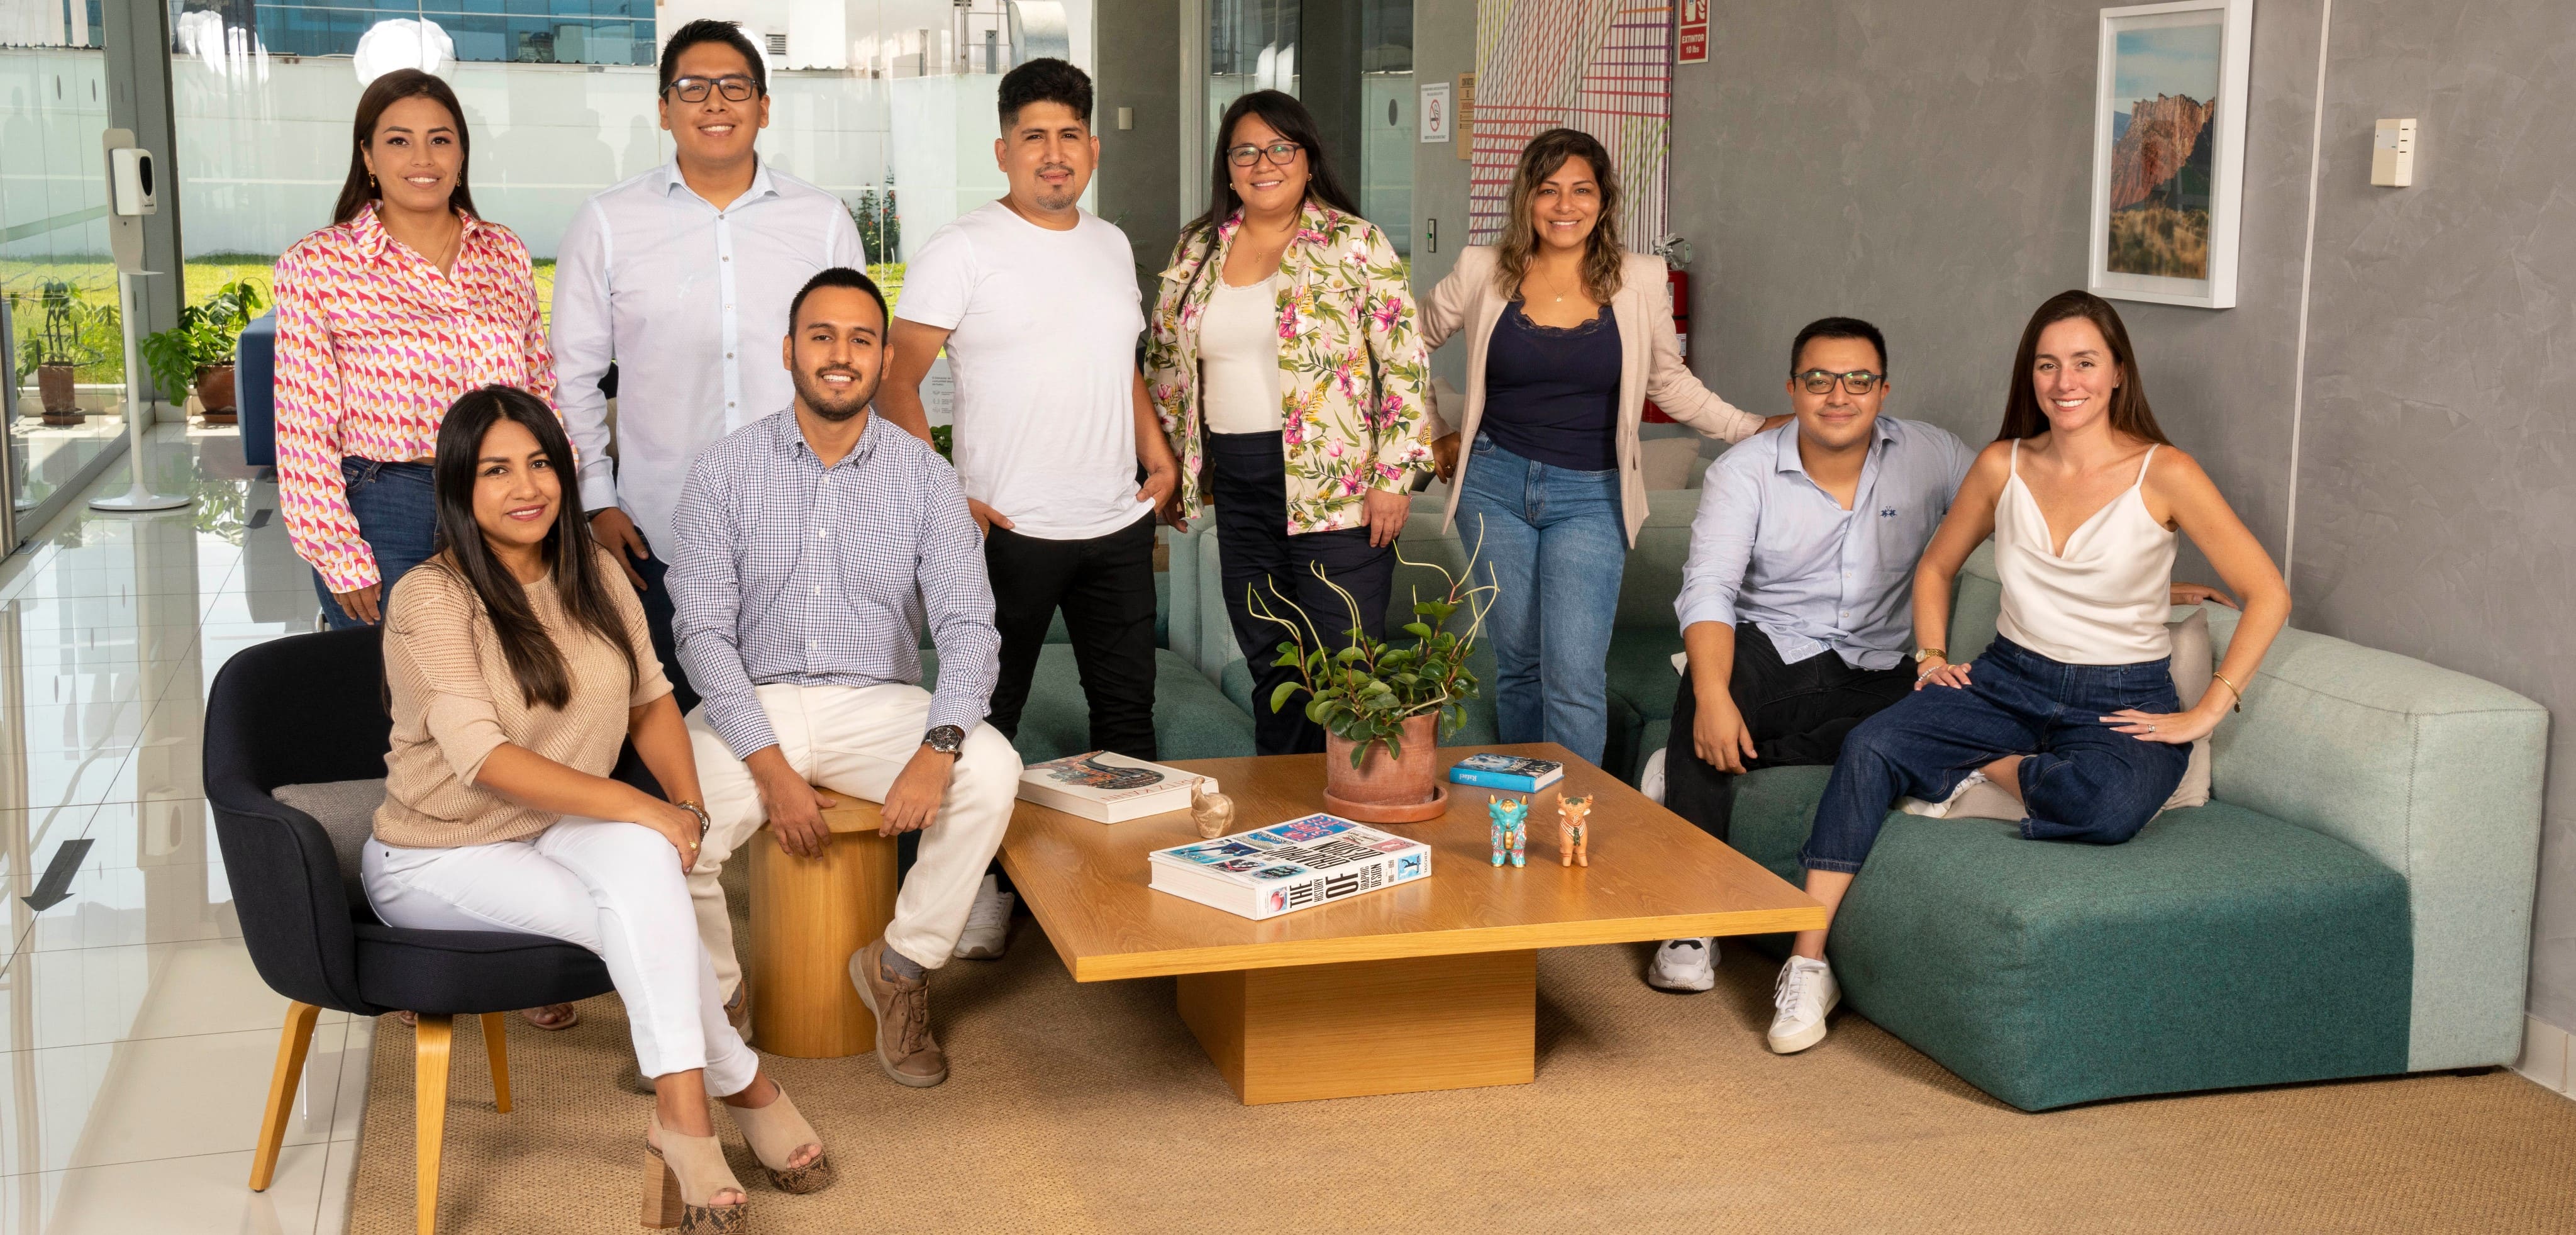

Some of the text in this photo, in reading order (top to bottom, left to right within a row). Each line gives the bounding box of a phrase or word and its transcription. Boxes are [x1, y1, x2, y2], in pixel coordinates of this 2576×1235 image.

[1682, 34, 1704, 43] EXTINTOR
[1686, 45, 1692, 53] 10
[1262, 846, 1350, 869] GRAPHIC
[1308, 841, 1385, 861] DESIGN
[1326, 873, 1358, 899] OF
[1360, 866, 1369, 890] GRAPHIC
[1370, 863, 1382, 888] DESIGN
[1290, 880, 1313, 908] THE
[1314, 878, 1324, 902] HISTORY
